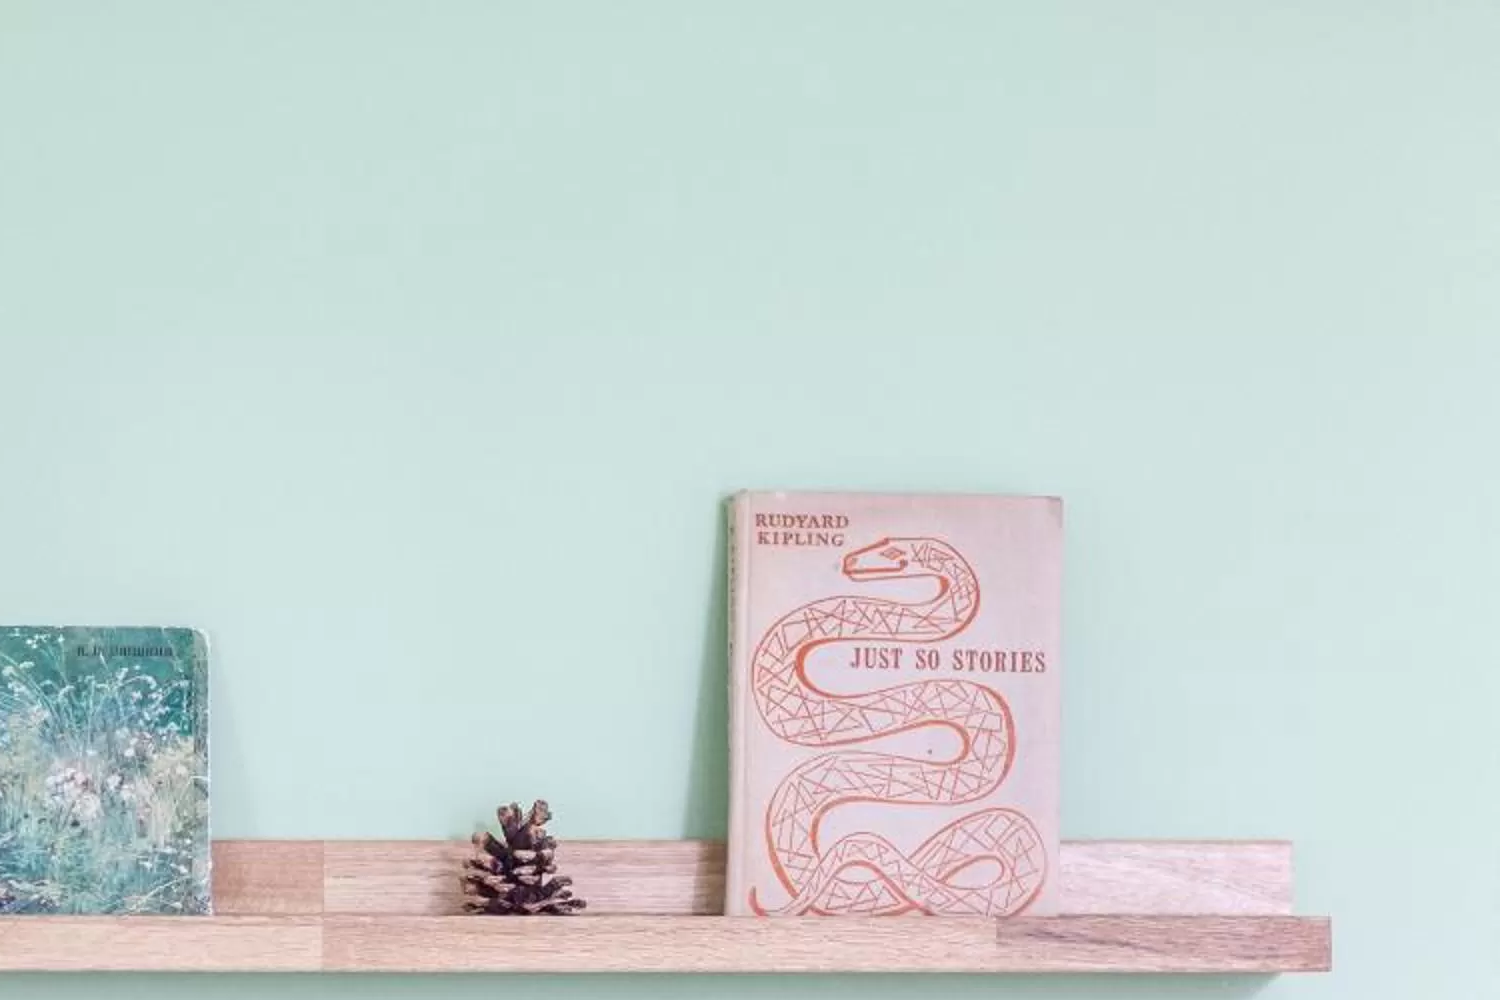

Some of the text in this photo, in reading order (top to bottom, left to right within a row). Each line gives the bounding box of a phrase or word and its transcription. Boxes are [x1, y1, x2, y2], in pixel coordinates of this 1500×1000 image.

[755, 513, 849, 529] RUDYARD
[757, 531, 845, 546] KIPLING
[851, 647, 1046, 673] JUST SO STORIES
